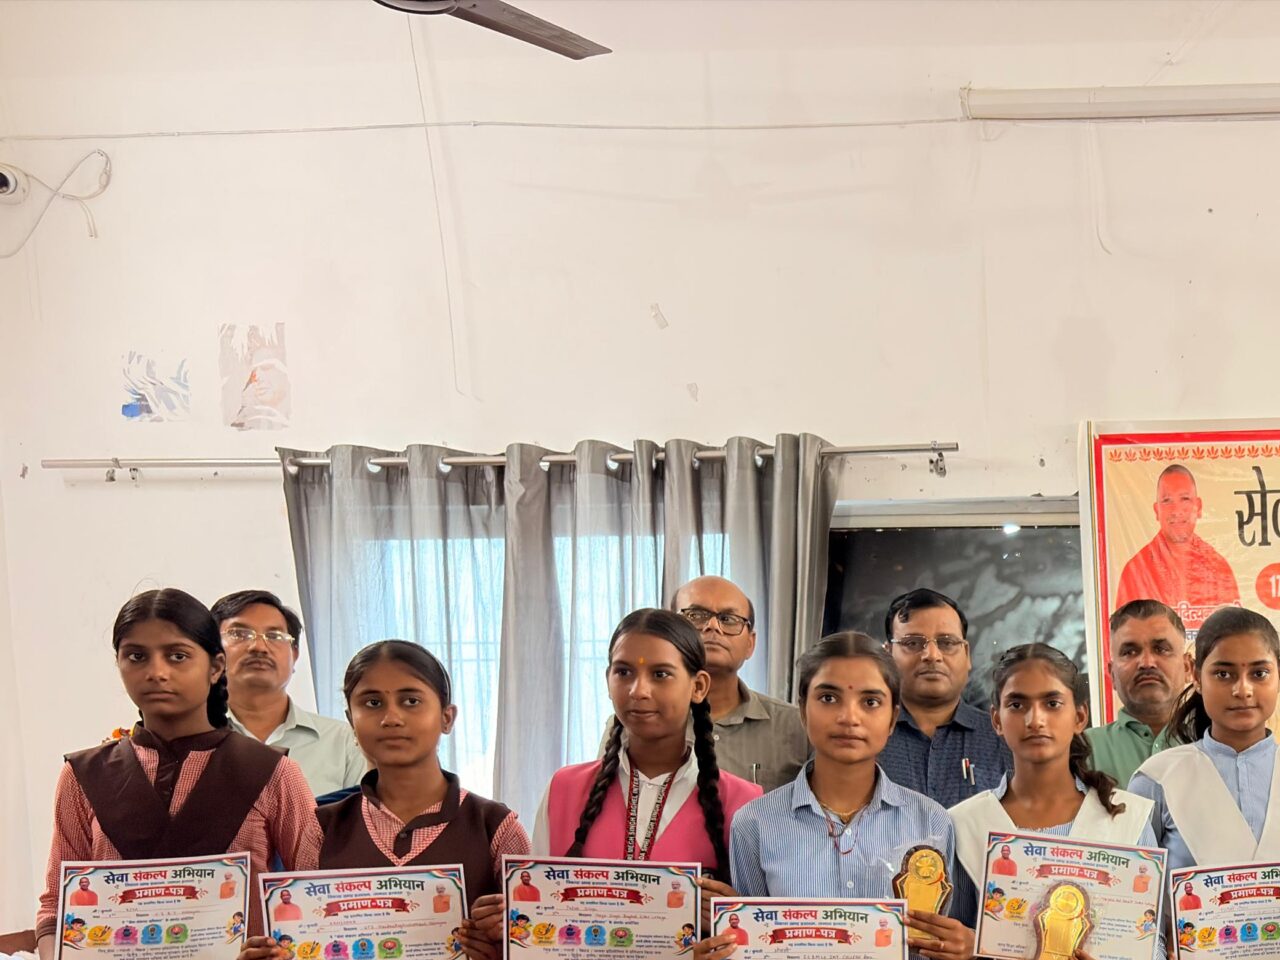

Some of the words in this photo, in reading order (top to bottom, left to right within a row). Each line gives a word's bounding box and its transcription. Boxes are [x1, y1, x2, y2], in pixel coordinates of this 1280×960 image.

[1023, 842, 1046, 857] सेवा
[1050, 846, 1083, 860] संकल्प
[1086, 850, 1130, 869] अभियान
[104, 871, 128, 885] सेवा
[133, 869, 167, 881] संकल्प
[171, 867, 215, 880] अभियान
[544, 867, 569, 881] सेवा
[573, 868, 609, 880] संकल्प
[614, 870, 661, 886] अभियान
[1050, 865, 1099, 879] प्रमाण-पत्र
[1203, 875, 1224, 888] सेवा
[1227, 870, 1257, 882] संकल्प
[135, 886, 185, 898] प्रमाण-पत्र
[304, 882, 330, 897] सेवा
[335, 879, 372, 892] संकल्प
[376, 877, 425, 892] अभियान
[576, 887, 628, 898] प्रमाण-पत्र
[1230, 887, 1275, 899] प्रमाण-पत्र
[339, 899, 393, 911] प्रमाण-पत्र
[753, 908, 778, 922] सेवा
[782, 908, 818, 920] संकल्प
[822, 908, 868, 923] अभियान
[784, 927, 837, 939] प्रमाण-पत्र
